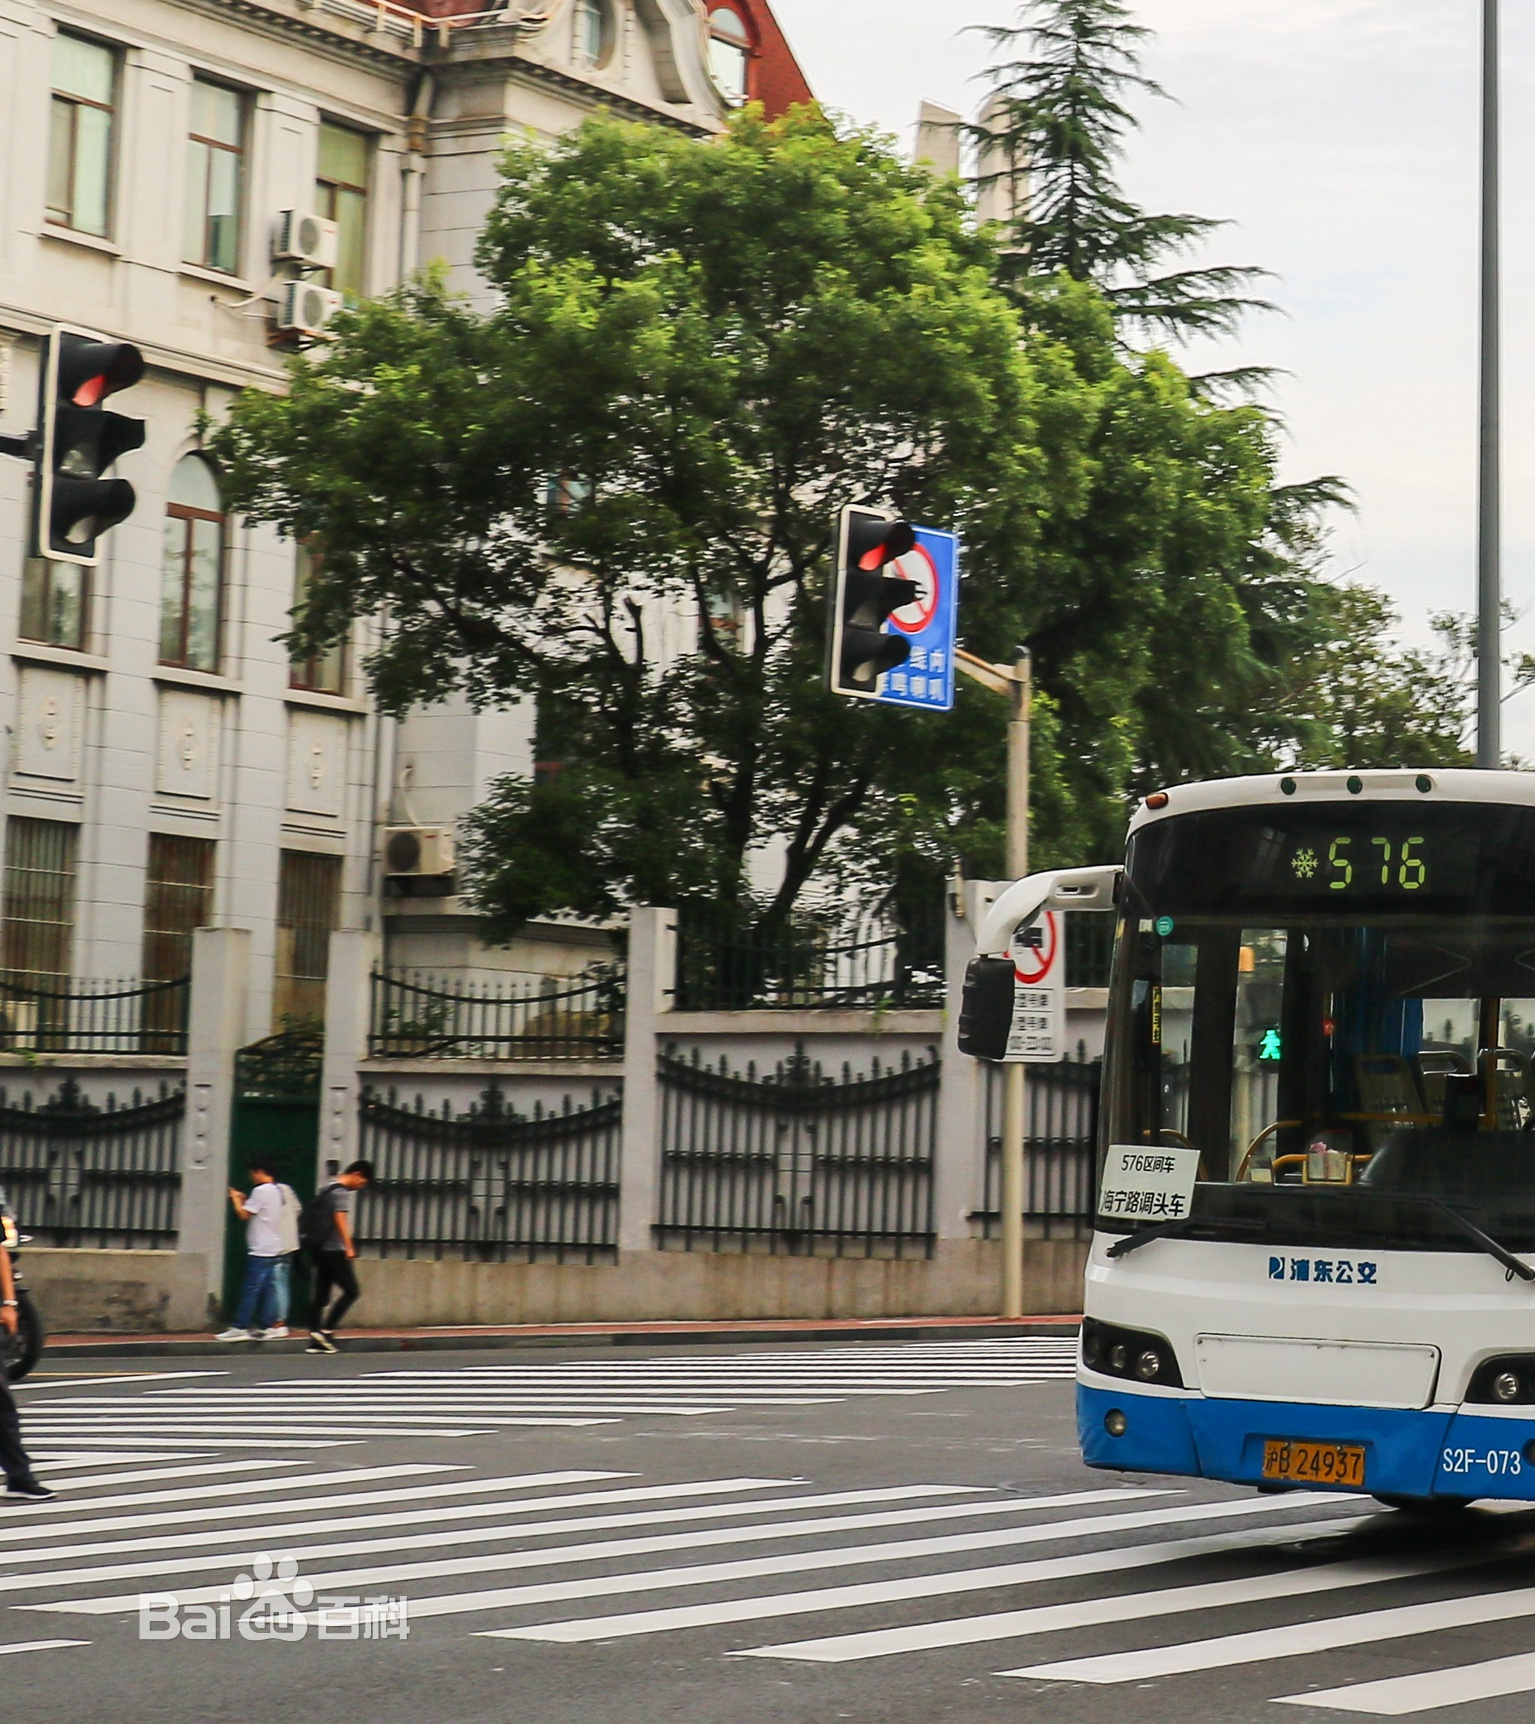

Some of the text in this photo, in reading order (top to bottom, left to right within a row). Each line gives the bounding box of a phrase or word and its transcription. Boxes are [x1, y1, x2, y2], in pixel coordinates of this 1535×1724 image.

[1328, 836, 1426, 890] 576
[1121, 1154, 1176, 1174] 576区间车
[1100, 1190, 1186, 1217] 海宁路调头车
[1289, 1257, 1378, 1285] 浦东公交
[1296, 1448, 1362, 1481] 24937
[1441, 1447, 1522, 1475] S2F-073
